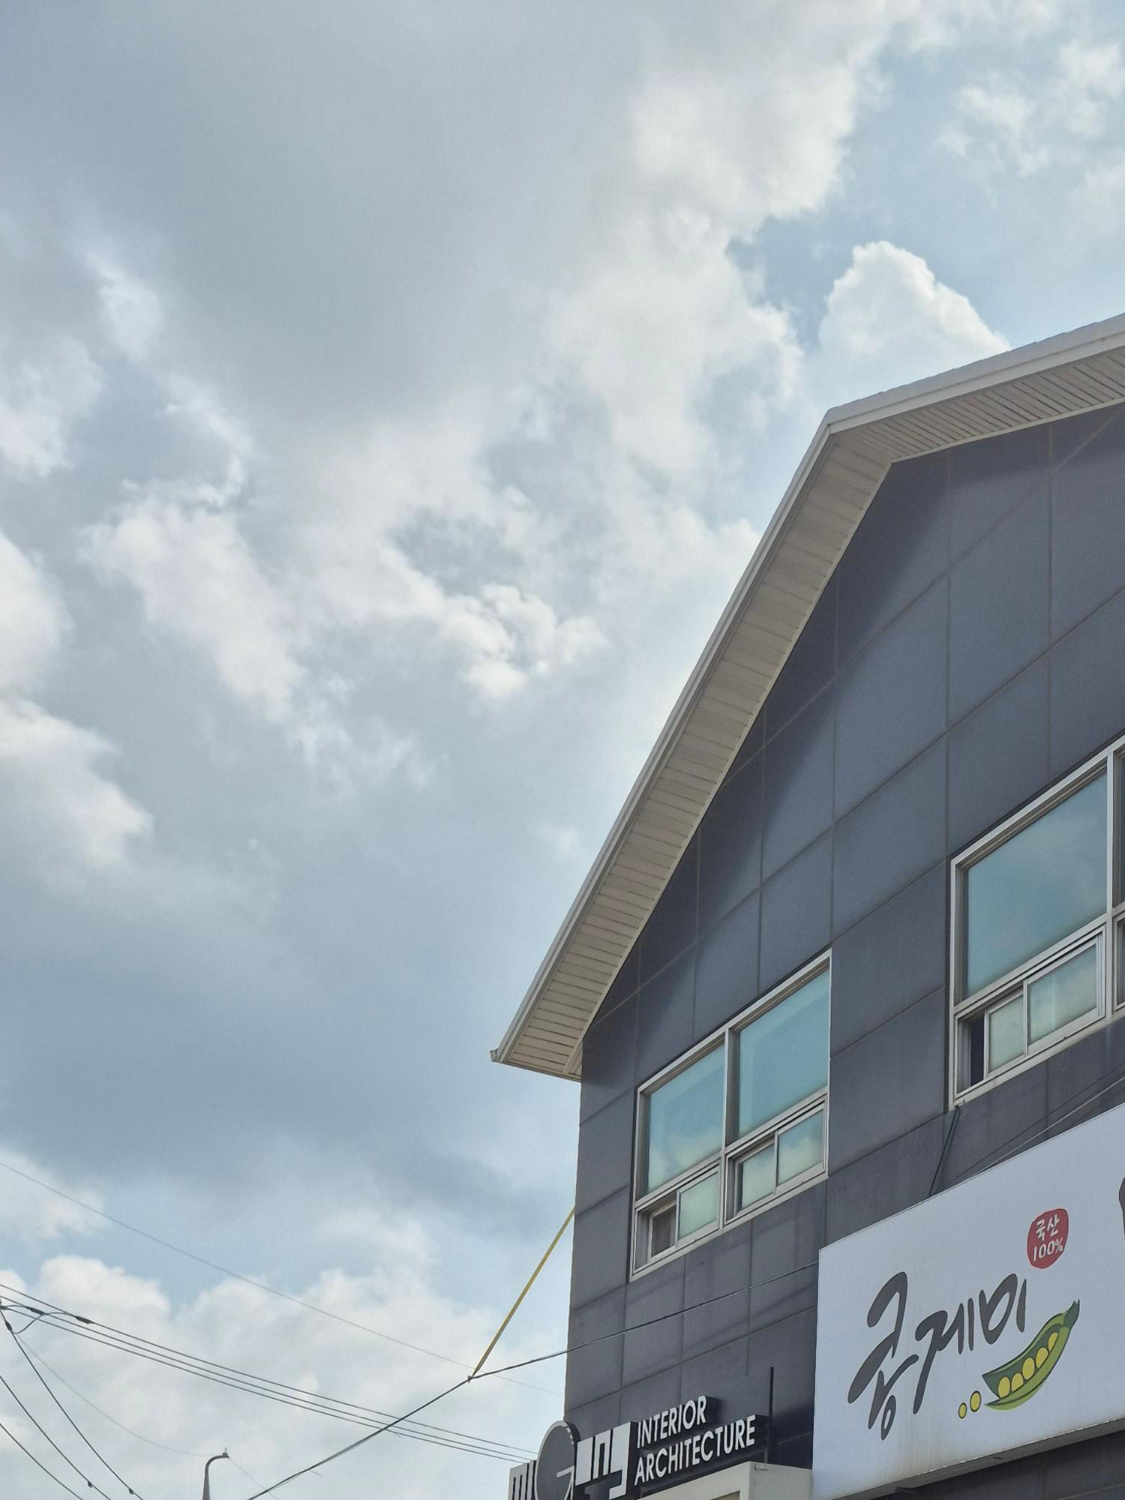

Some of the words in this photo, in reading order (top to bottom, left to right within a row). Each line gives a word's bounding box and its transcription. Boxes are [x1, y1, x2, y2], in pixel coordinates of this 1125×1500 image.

[1036, 1213, 1061, 1242] 국산
[1033, 1236, 1064, 1262] 100%
[637, 1395, 707, 1449] INTERIOR
[634, 1414, 756, 1486] ARCHITECTURE
